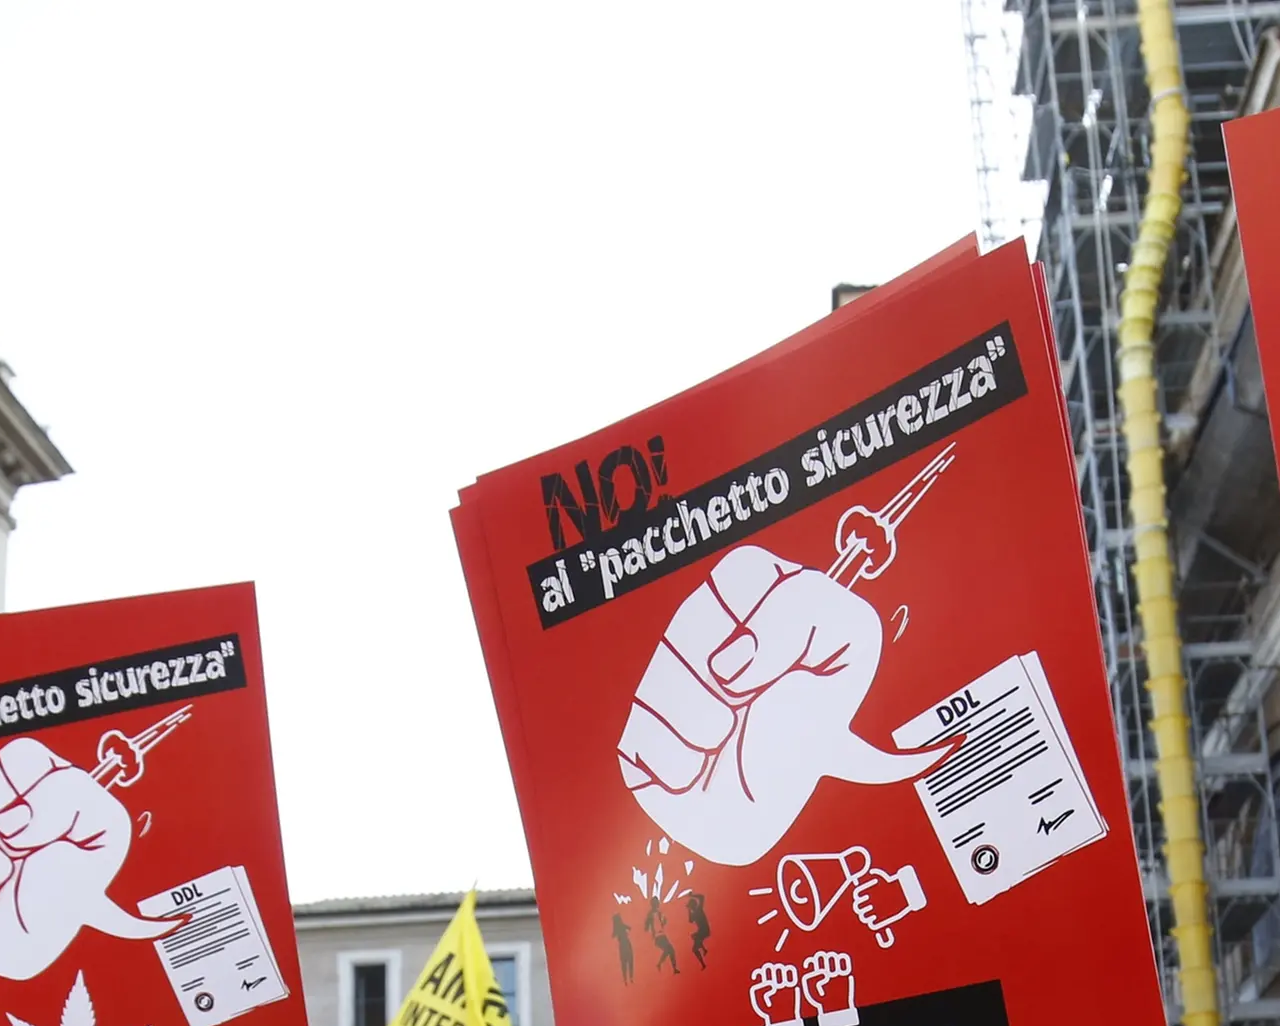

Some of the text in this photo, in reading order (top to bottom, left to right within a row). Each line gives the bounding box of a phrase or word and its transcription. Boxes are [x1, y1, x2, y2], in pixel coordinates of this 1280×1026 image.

[540, 335, 1007, 612] al "pacchetto sicurezza"
[540, 435, 668, 551] NO!
[76, 641, 235, 708] sicurezza"
[936, 689, 981, 728] DDL
[171, 883, 203, 906] DDL
